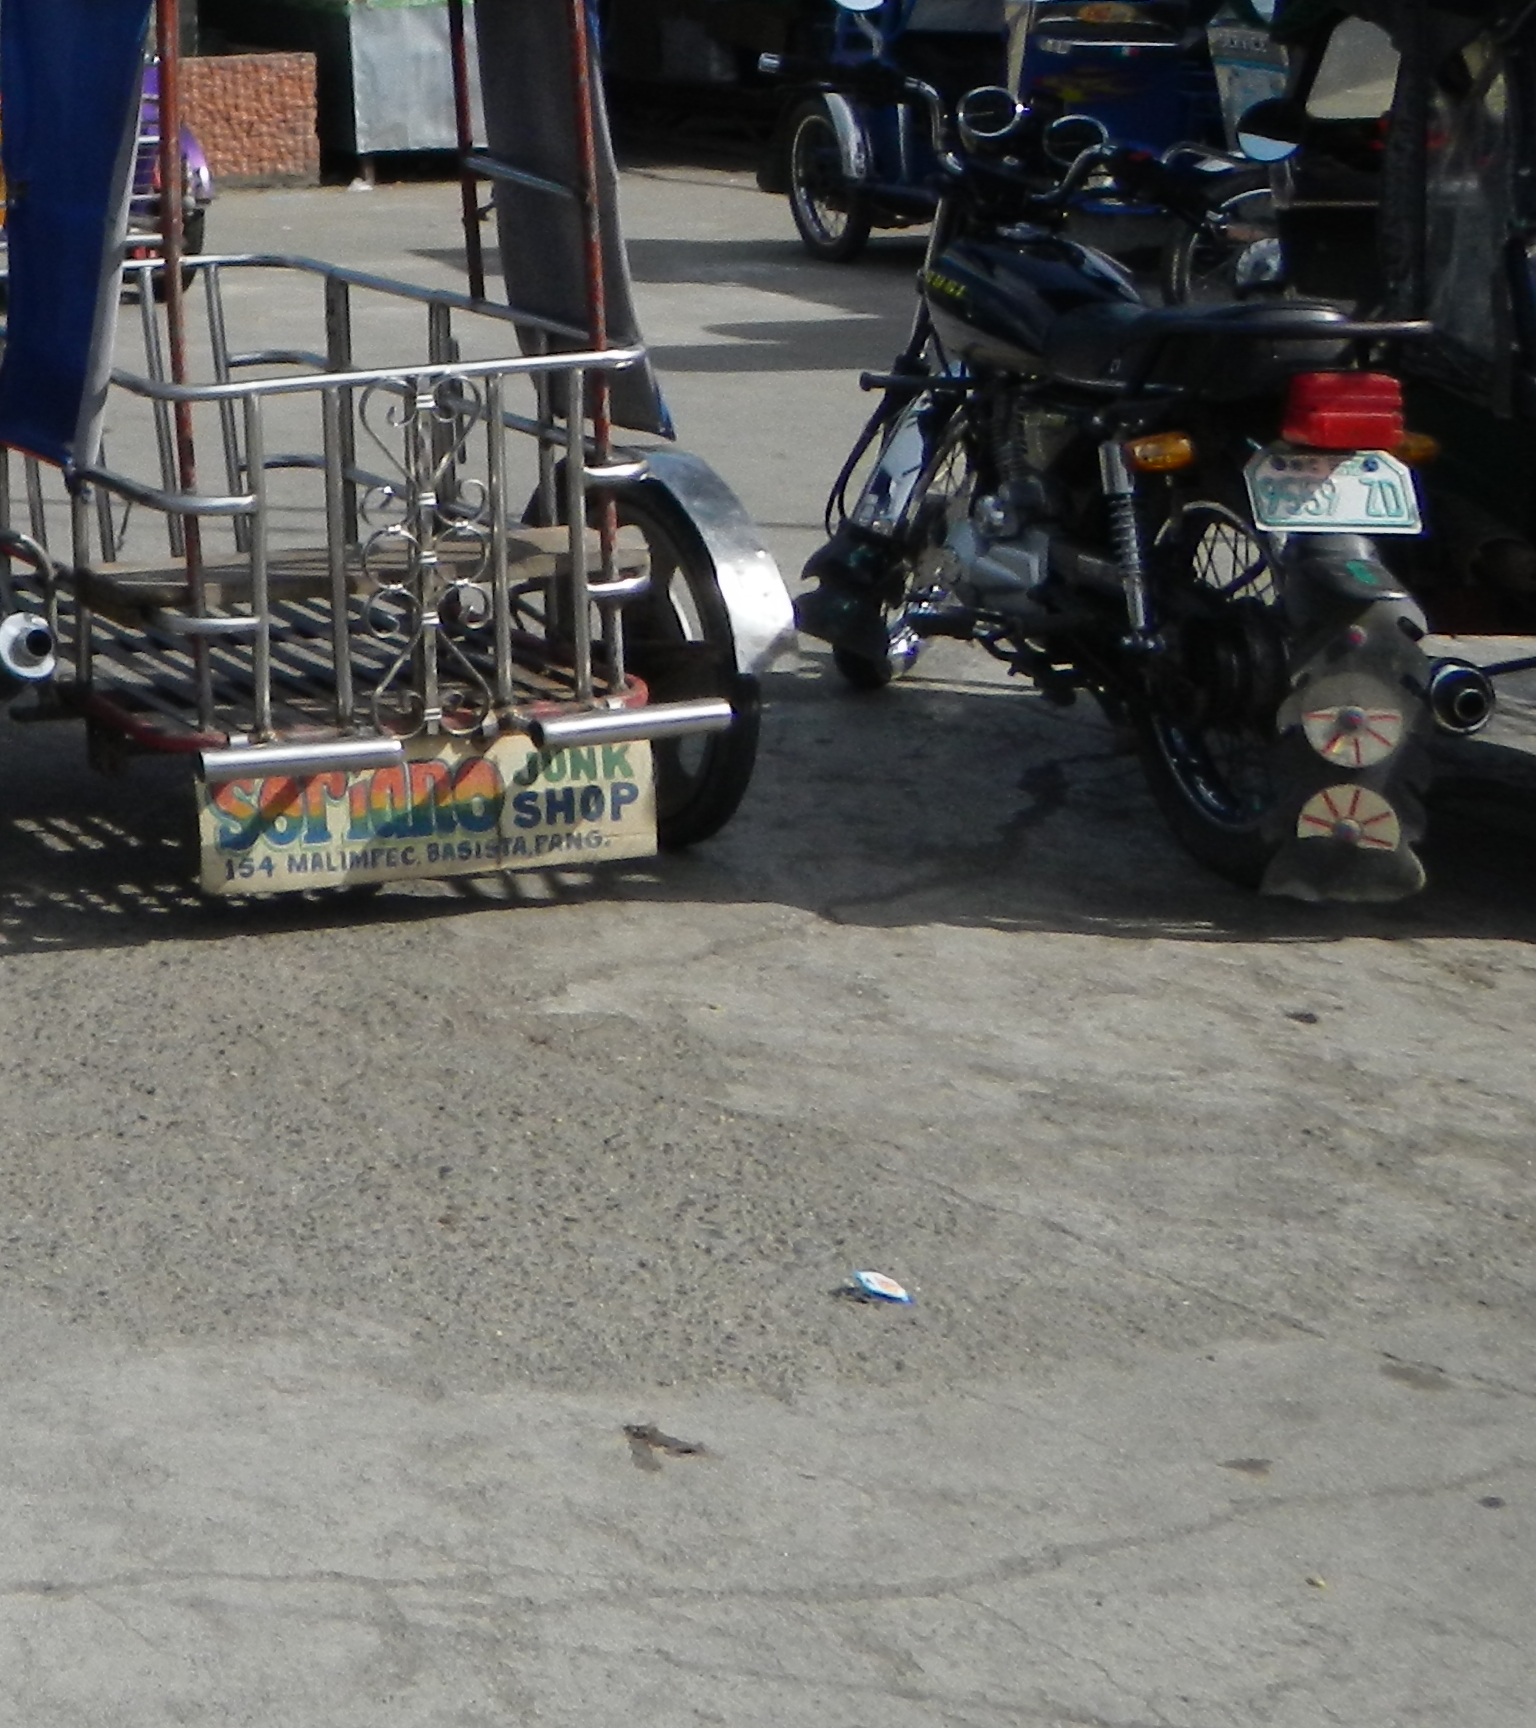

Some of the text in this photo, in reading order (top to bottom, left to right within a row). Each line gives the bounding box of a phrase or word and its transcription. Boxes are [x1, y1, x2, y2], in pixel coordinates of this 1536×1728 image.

[513, 743, 635, 787] JUNK
[512, 781, 640, 830] SHOP
[225, 854, 274, 882] 154
